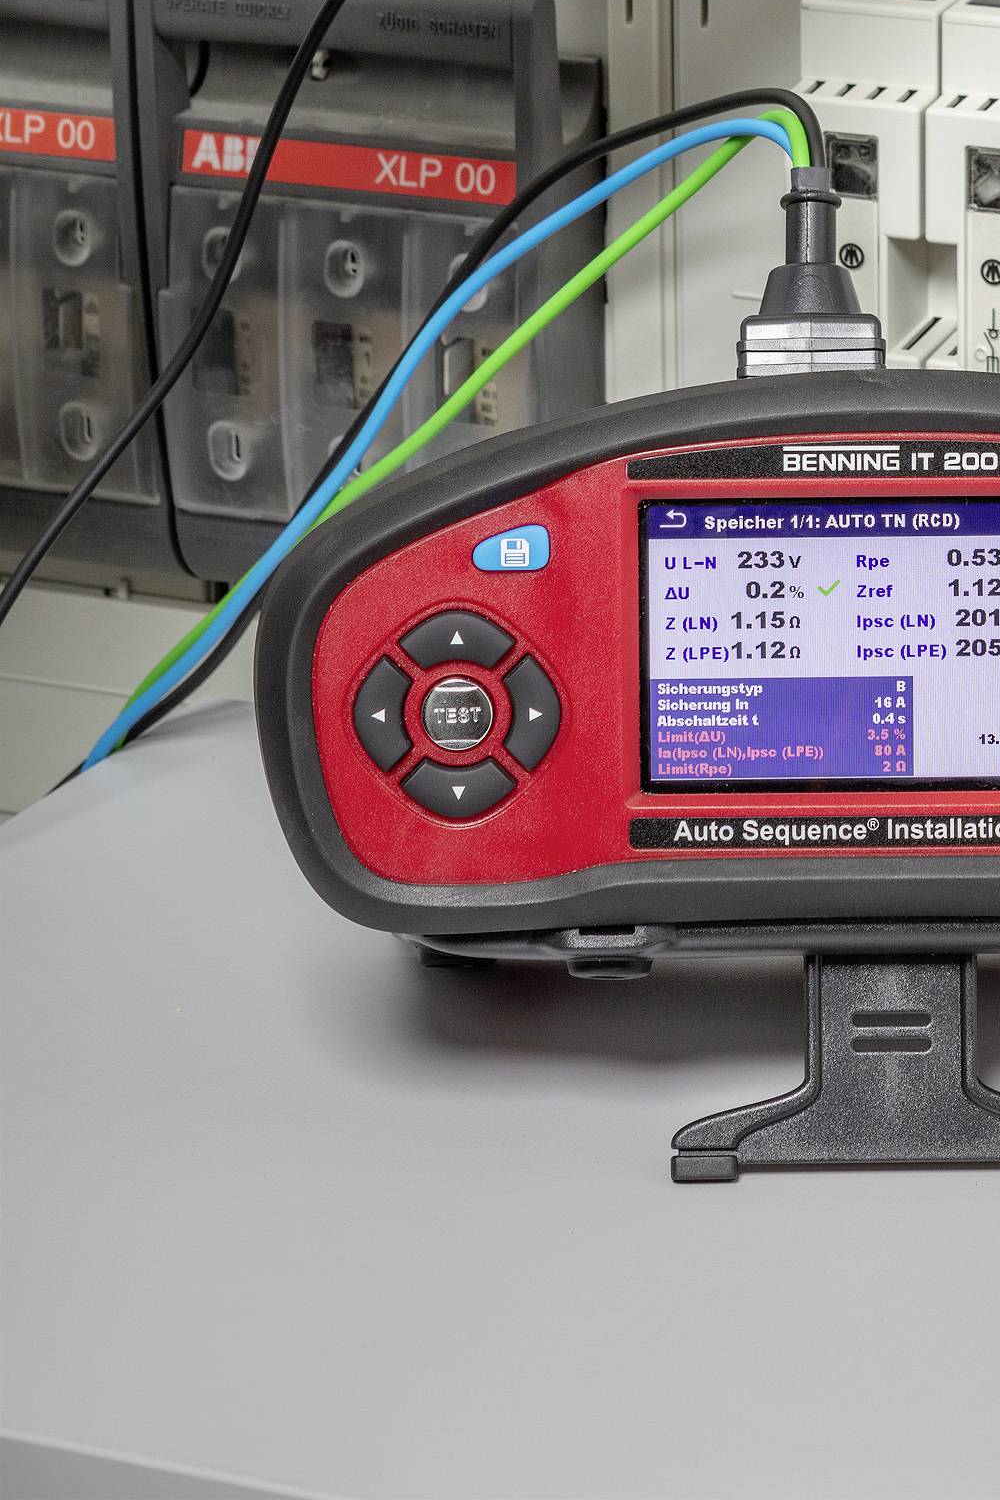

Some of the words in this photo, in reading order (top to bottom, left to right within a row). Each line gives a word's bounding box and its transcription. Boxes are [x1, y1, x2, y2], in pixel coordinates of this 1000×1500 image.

[0, 111, 45, 145] LP
[57, 117, 96, 151] 00
[374, 152, 442, 189] XLP
[455, 162, 496, 196] 00
[783, 451, 900, 472] BENNING
[911, 452, 935, 471] IT
[944, 452, 999, 471] 200
[705, 514, 784, 533] Speicher
[791, 514, 821, 529] 1/1:
[825, 513, 876, 529] AUTO
[881, 513, 906, 528] TN
[912, 513, 961, 530] (RCD)
[665, 556, 676, 570] U
[738, 550, 785, 569] 233
[856, 555, 890, 571] Rpe
[665, 586, 690, 601] ΔU
[745, 580, 786, 599] 0.2
[789, 585, 804, 599] %
[856, 584, 893, 598] Zref
[665, 617, 676, 630] Z
[682, 616, 718, 633] (LN)
[731, 611, 785, 630] 1.15
[856, 614, 894, 631] Ipsc
[900, 614, 936, 630] (LN)
[956, 608, 1000, 627] 201
[665, 647, 676, 660] Z
[682, 646, 729, 663] (LPE)
[731, 641, 786, 660] 1.12
[857, 644, 894, 661] Ipsc
[900, 643, 947, 661] (LPE)
[657, 682, 763, 698] Sicherungstyp
[896, 680, 906, 692] B
[657, 699, 731, 713] Sicherung
[874, 697, 892, 708] 16
[895, 697, 906, 708] A
[434, 706, 482, 724] TEST
[657, 714, 749, 727] Abschaltzeit
[751, 714, 759, 727] t
[872, 713, 894, 724] 0.4
[897, 714, 906, 724] s
[657, 730, 726, 745] Limit(ΔU)
[867, 729, 889, 741] 3.5
[894, 728, 906, 740] %
[782, 745, 824, 761] (LPE))
[874, 745, 892, 757] 80
[895, 745, 906, 756] A
[657, 763, 732, 777] Limit(Rpe)
[882, 761, 892, 773] 2
[673, 819, 734, 842] Auto
